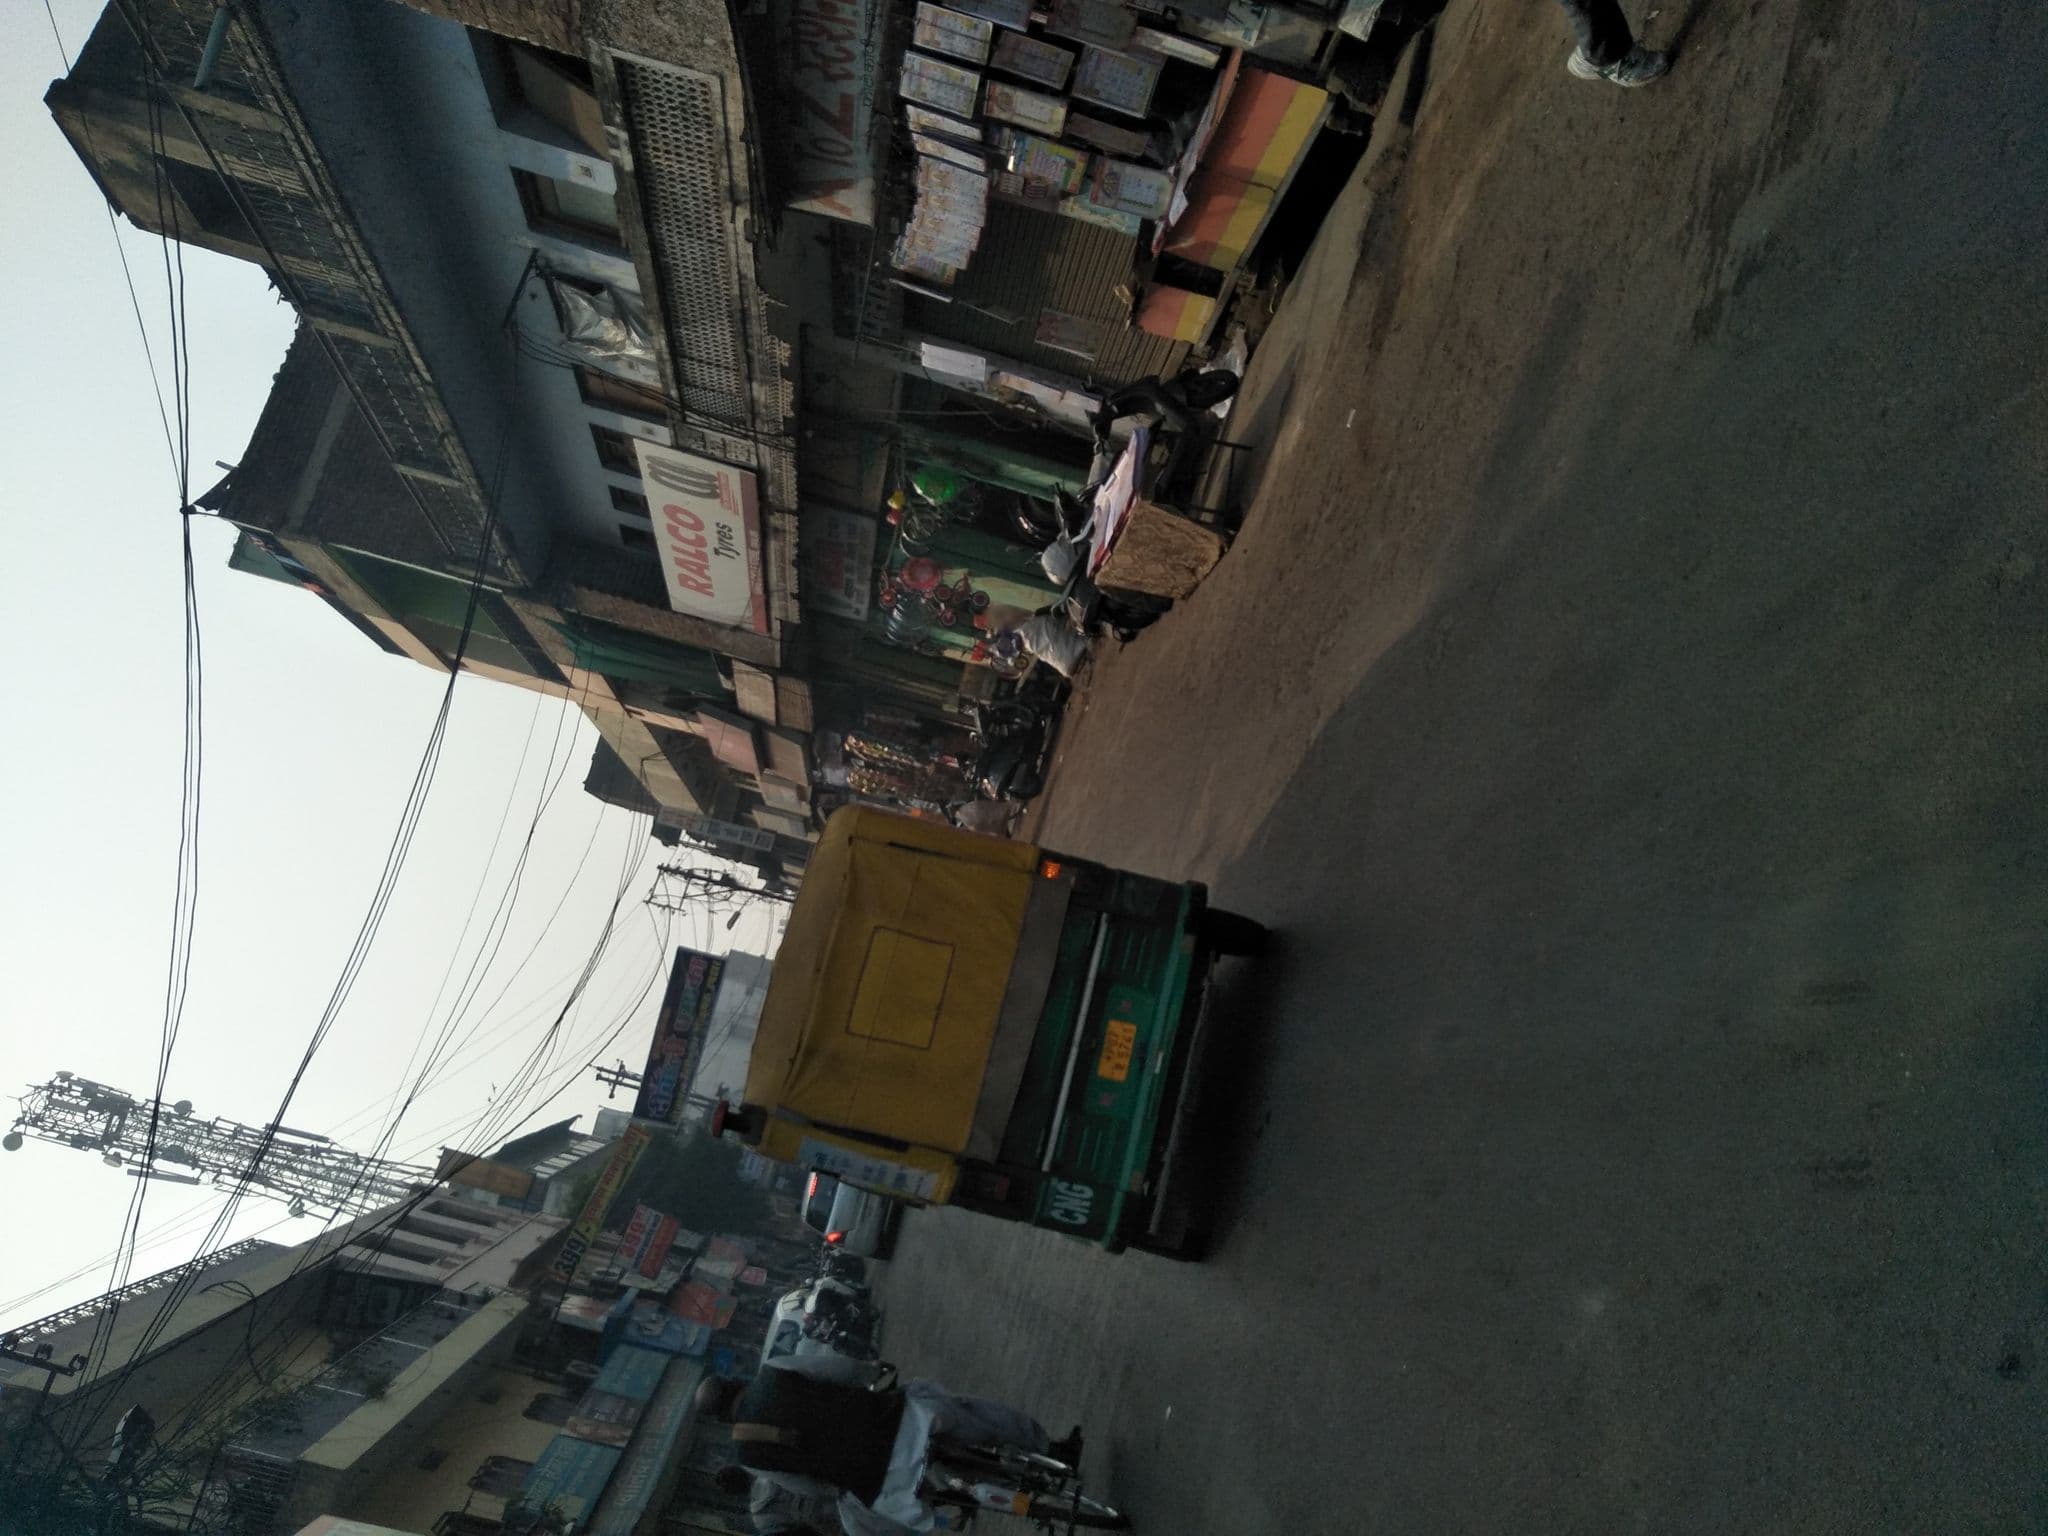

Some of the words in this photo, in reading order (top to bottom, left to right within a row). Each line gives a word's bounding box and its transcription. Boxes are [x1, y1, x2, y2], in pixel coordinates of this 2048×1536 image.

[799, 86, 854, 140] Z
[793, 177, 853, 217] A
[662, 502, 715, 596] RALCO
[714, 521, 740, 560] Tyres
[1050, 1181, 1094, 1224] CNG
